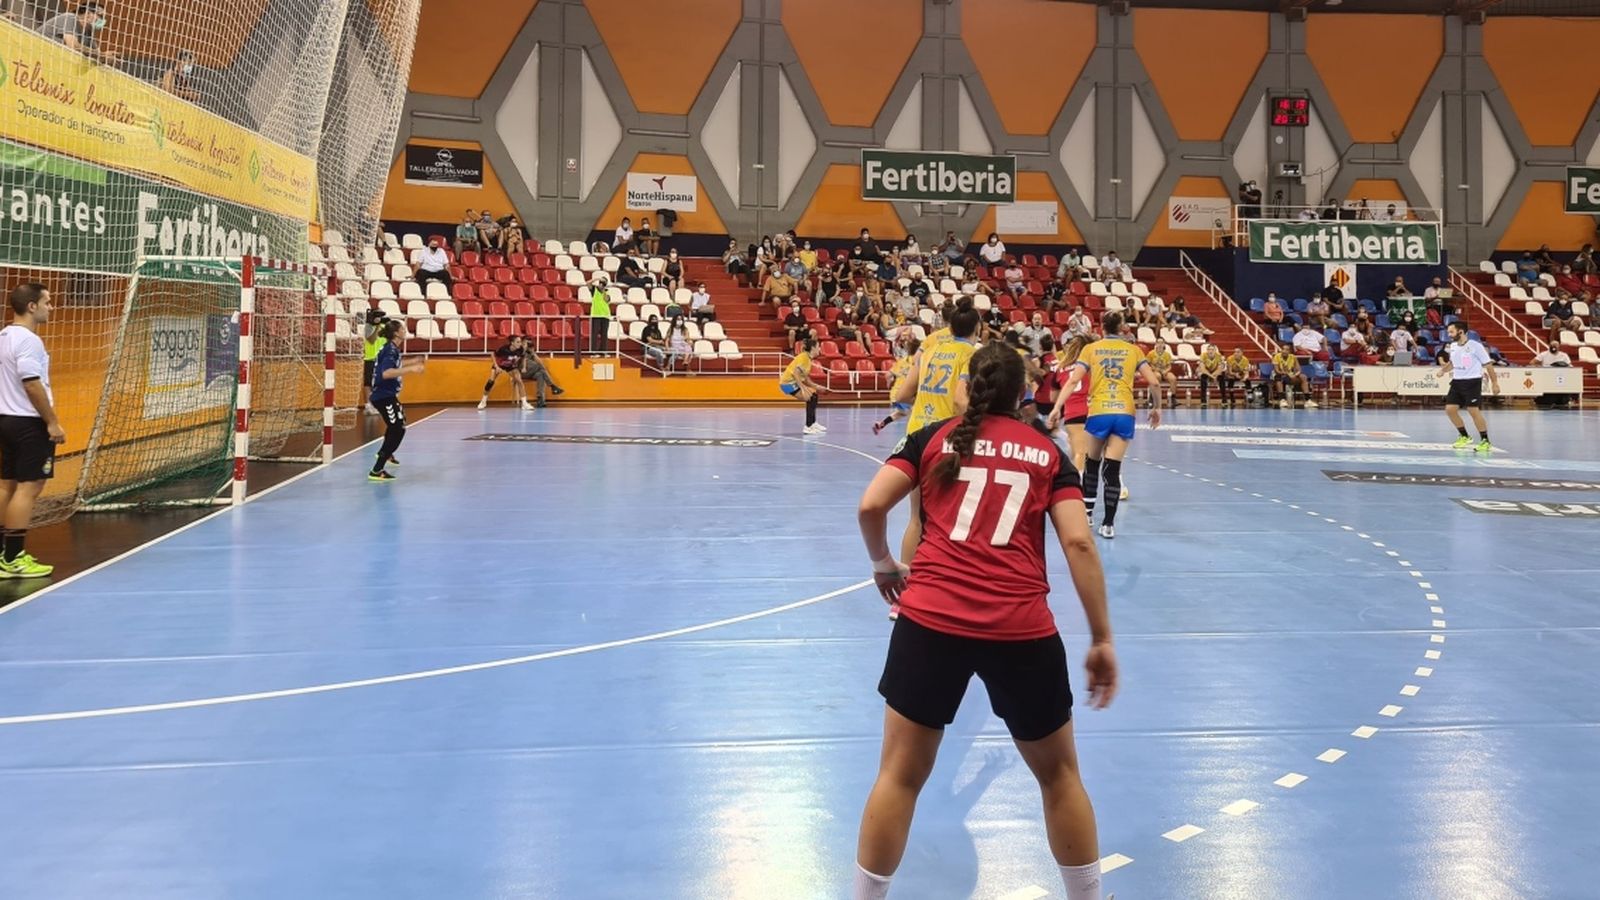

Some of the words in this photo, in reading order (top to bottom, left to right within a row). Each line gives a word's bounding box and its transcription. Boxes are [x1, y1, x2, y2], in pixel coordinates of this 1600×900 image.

[409, 165, 443, 174] TALLERES
[444, 168, 479, 176] SALVADOR
[866, 160, 1012, 194] Fertiberia
[628, 191, 694, 203] NorteHispana
[1571, 177, 1600, 204] Fe
[138, 191, 269, 281] Fertiberia
[1263, 226, 1426, 260] Fertiberia
[1100, 358, 1125, 379] 15
[1403, 380, 1439, 389] Fertiberia
[1001, 441, 1050, 467] OLMO
[949, 466, 1030, 546] 77
